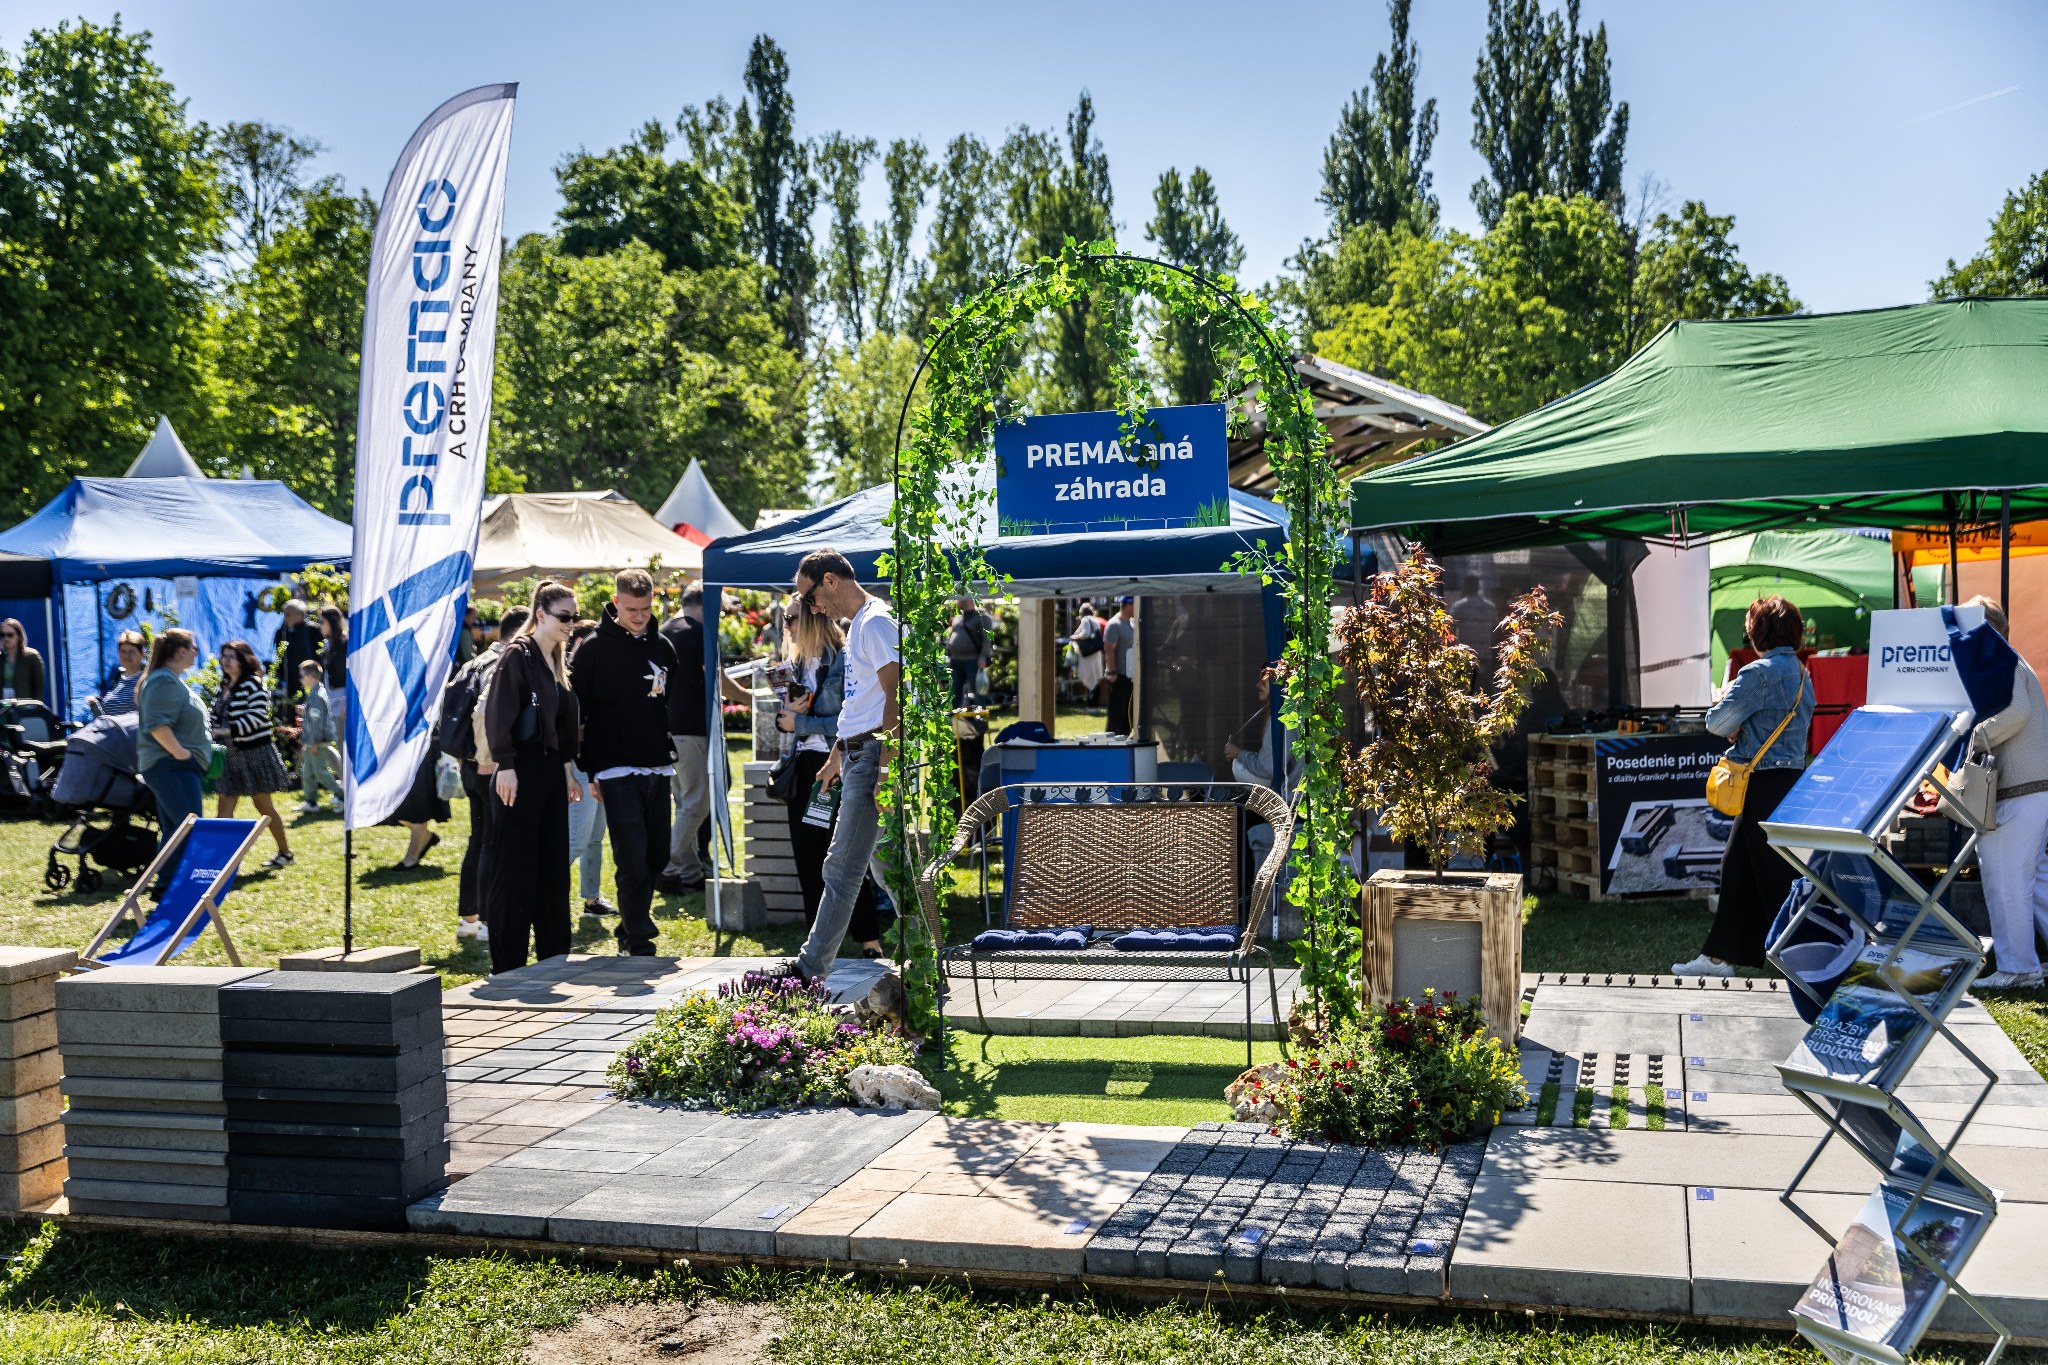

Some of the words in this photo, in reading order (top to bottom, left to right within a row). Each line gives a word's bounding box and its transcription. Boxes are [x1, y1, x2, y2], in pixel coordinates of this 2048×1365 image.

[454, 244, 480, 375] COMPANY
[398, 178, 457, 527] premac
[449, 381, 467, 437] CRH
[448, 441, 468, 460] A
[1054, 473, 1167, 502] záhrada
[1607, 753, 1675, 770] Posedenie
[1678, 752, 1696, 769] pri
[1613, 774, 1637, 783] dlažby
[1676, 771, 1694, 781] plota
[1811, 1028, 1837, 1043] PRE
[1818, 1017, 1868, 1037] DLAŽBY
[1808, 1287, 1879, 1325] PRÍRODOU
